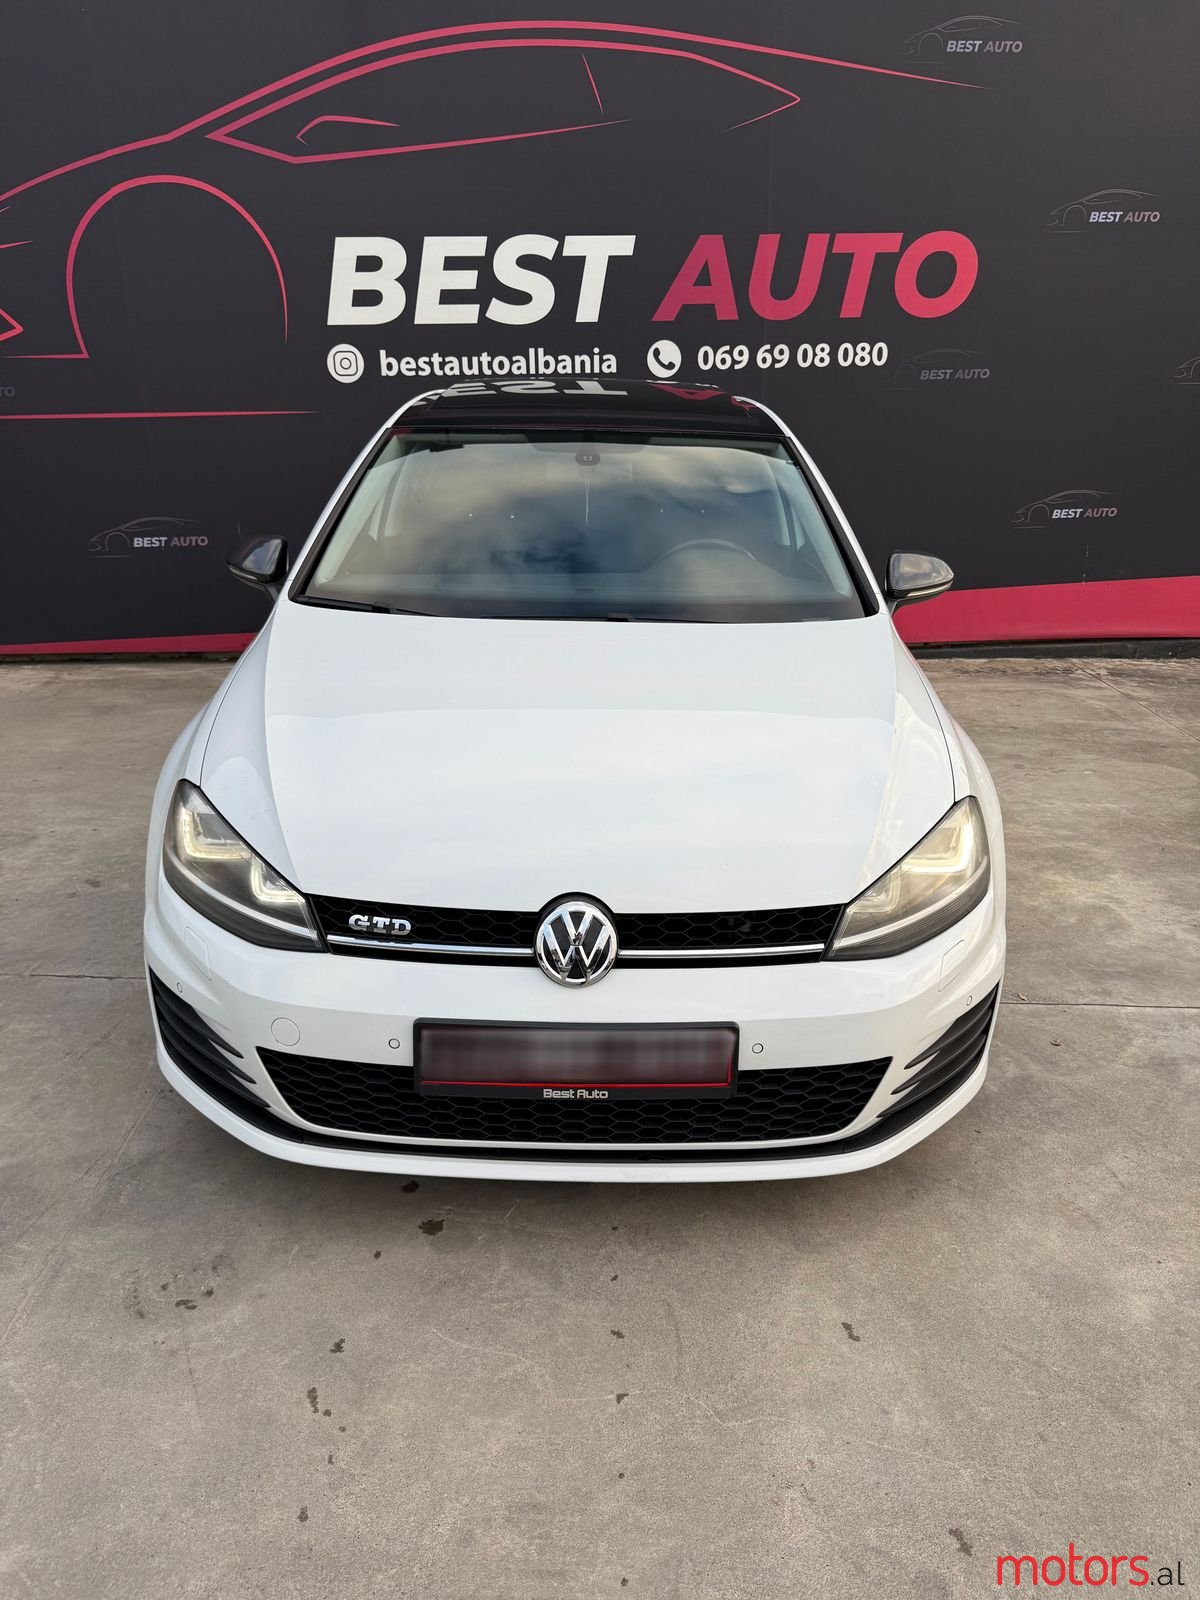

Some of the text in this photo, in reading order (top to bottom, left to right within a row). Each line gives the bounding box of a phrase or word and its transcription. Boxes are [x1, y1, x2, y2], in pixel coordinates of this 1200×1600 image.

[945, 40, 1023, 53] BEST AUTO
[1088, 211, 1161, 223] BEST AUTO
[326, 230, 979, 326] BEST AUTO
[379, 347, 618, 378] bestautoalbania
[697, 341, 889, 371] 069 69 08 080
[919, 368, 991, 380] BEST AUTO
[1051, 507, 1118, 519] BEST AUTO
[132, 535, 209, 548] BEST AUTO
[348, 914, 412, 936] GTD
[543, 1088, 609, 1099] Best Auto
